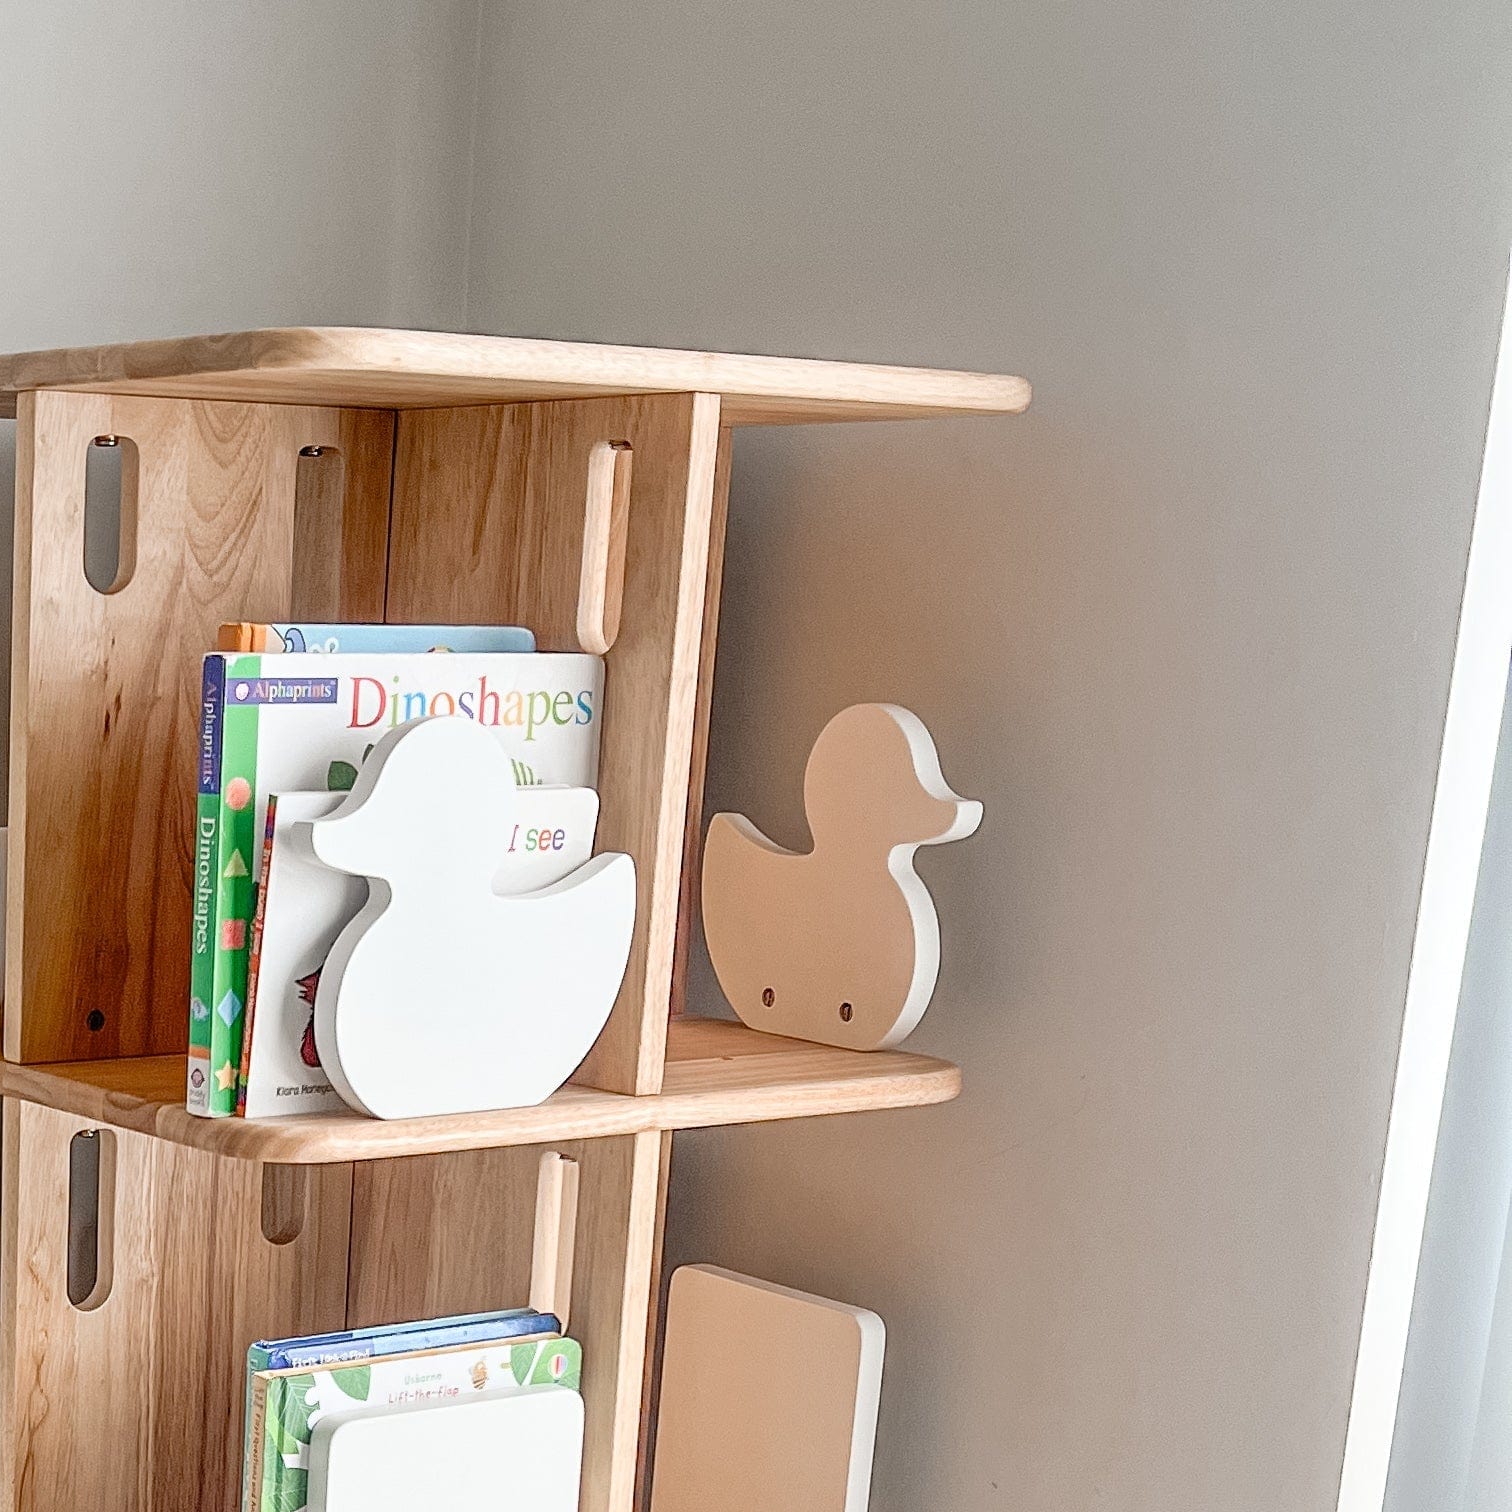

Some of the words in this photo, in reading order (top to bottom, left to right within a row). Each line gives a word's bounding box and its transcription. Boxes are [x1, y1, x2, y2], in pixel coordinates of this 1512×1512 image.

[252, 680, 332, 703] Alphaprints
[346, 676, 593, 741] Dinoshapes
[201, 681, 217, 785] Alphaprints
[508, 824, 519, 852] I
[526, 828, 565, 851] see
[195, 817, 215, 954] Dinoshapes
